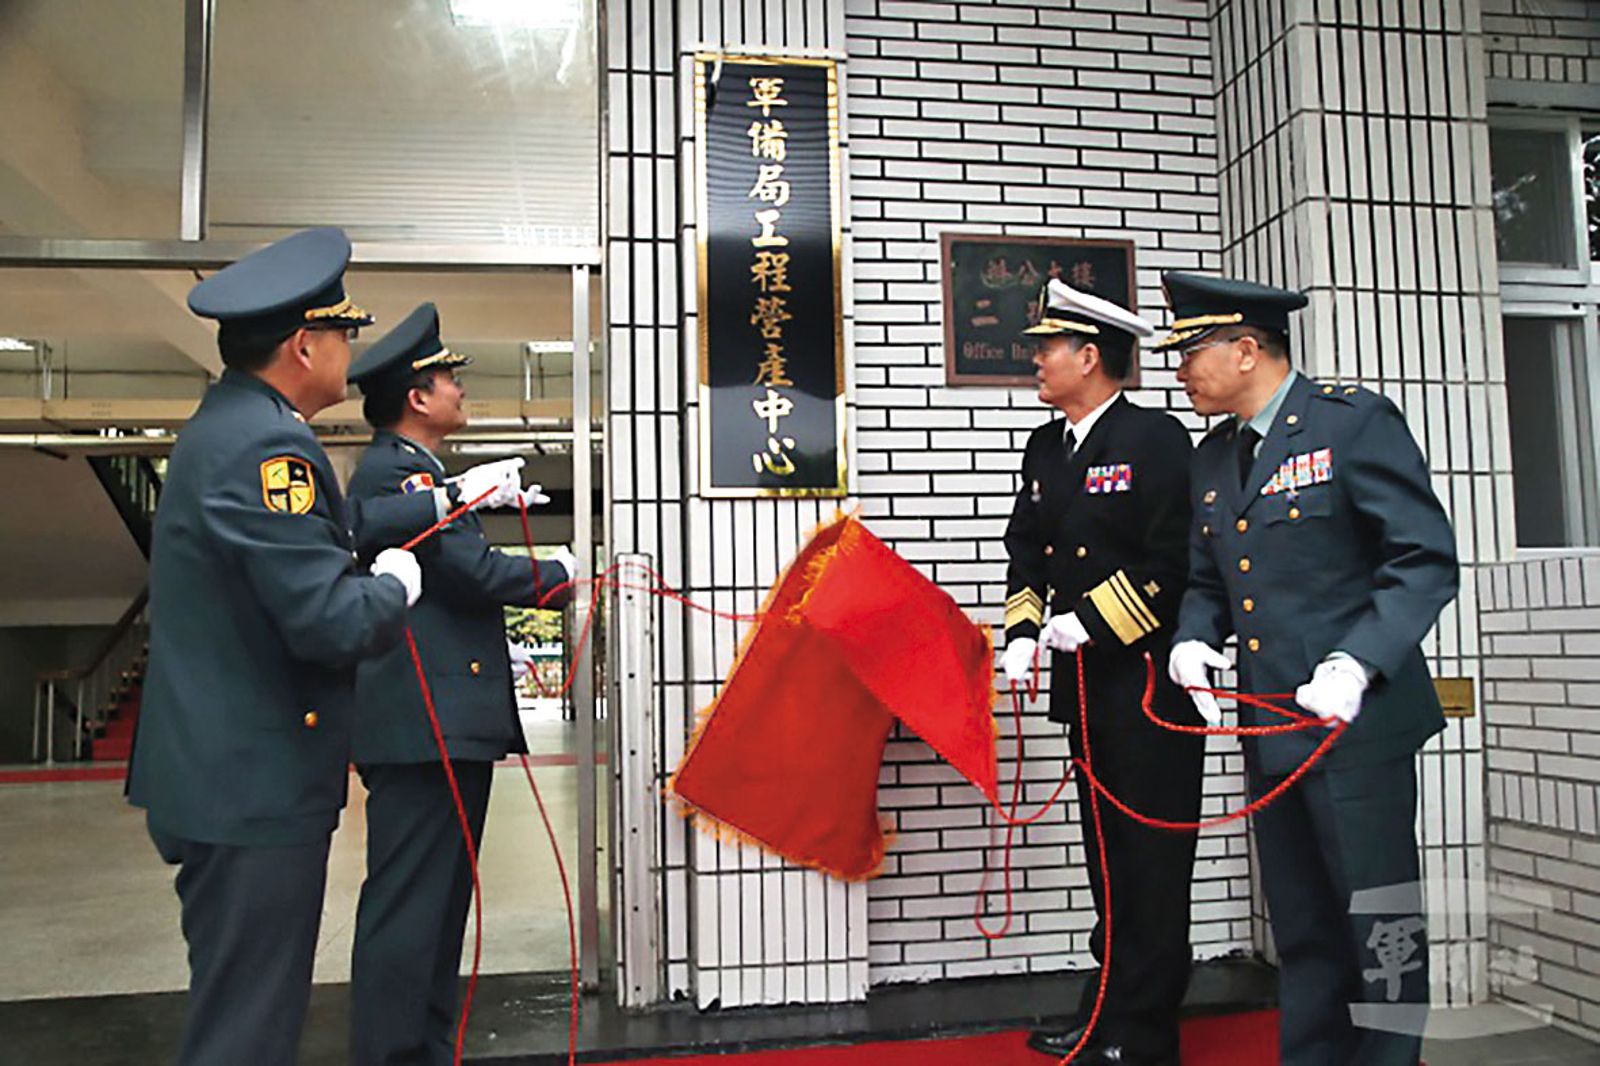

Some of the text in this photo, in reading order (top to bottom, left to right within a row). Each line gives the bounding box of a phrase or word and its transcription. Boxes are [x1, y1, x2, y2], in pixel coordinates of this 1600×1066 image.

[747, 76, 796, 475] 軍備局工程營產中心
[963, 341, 1004, 360] Office
